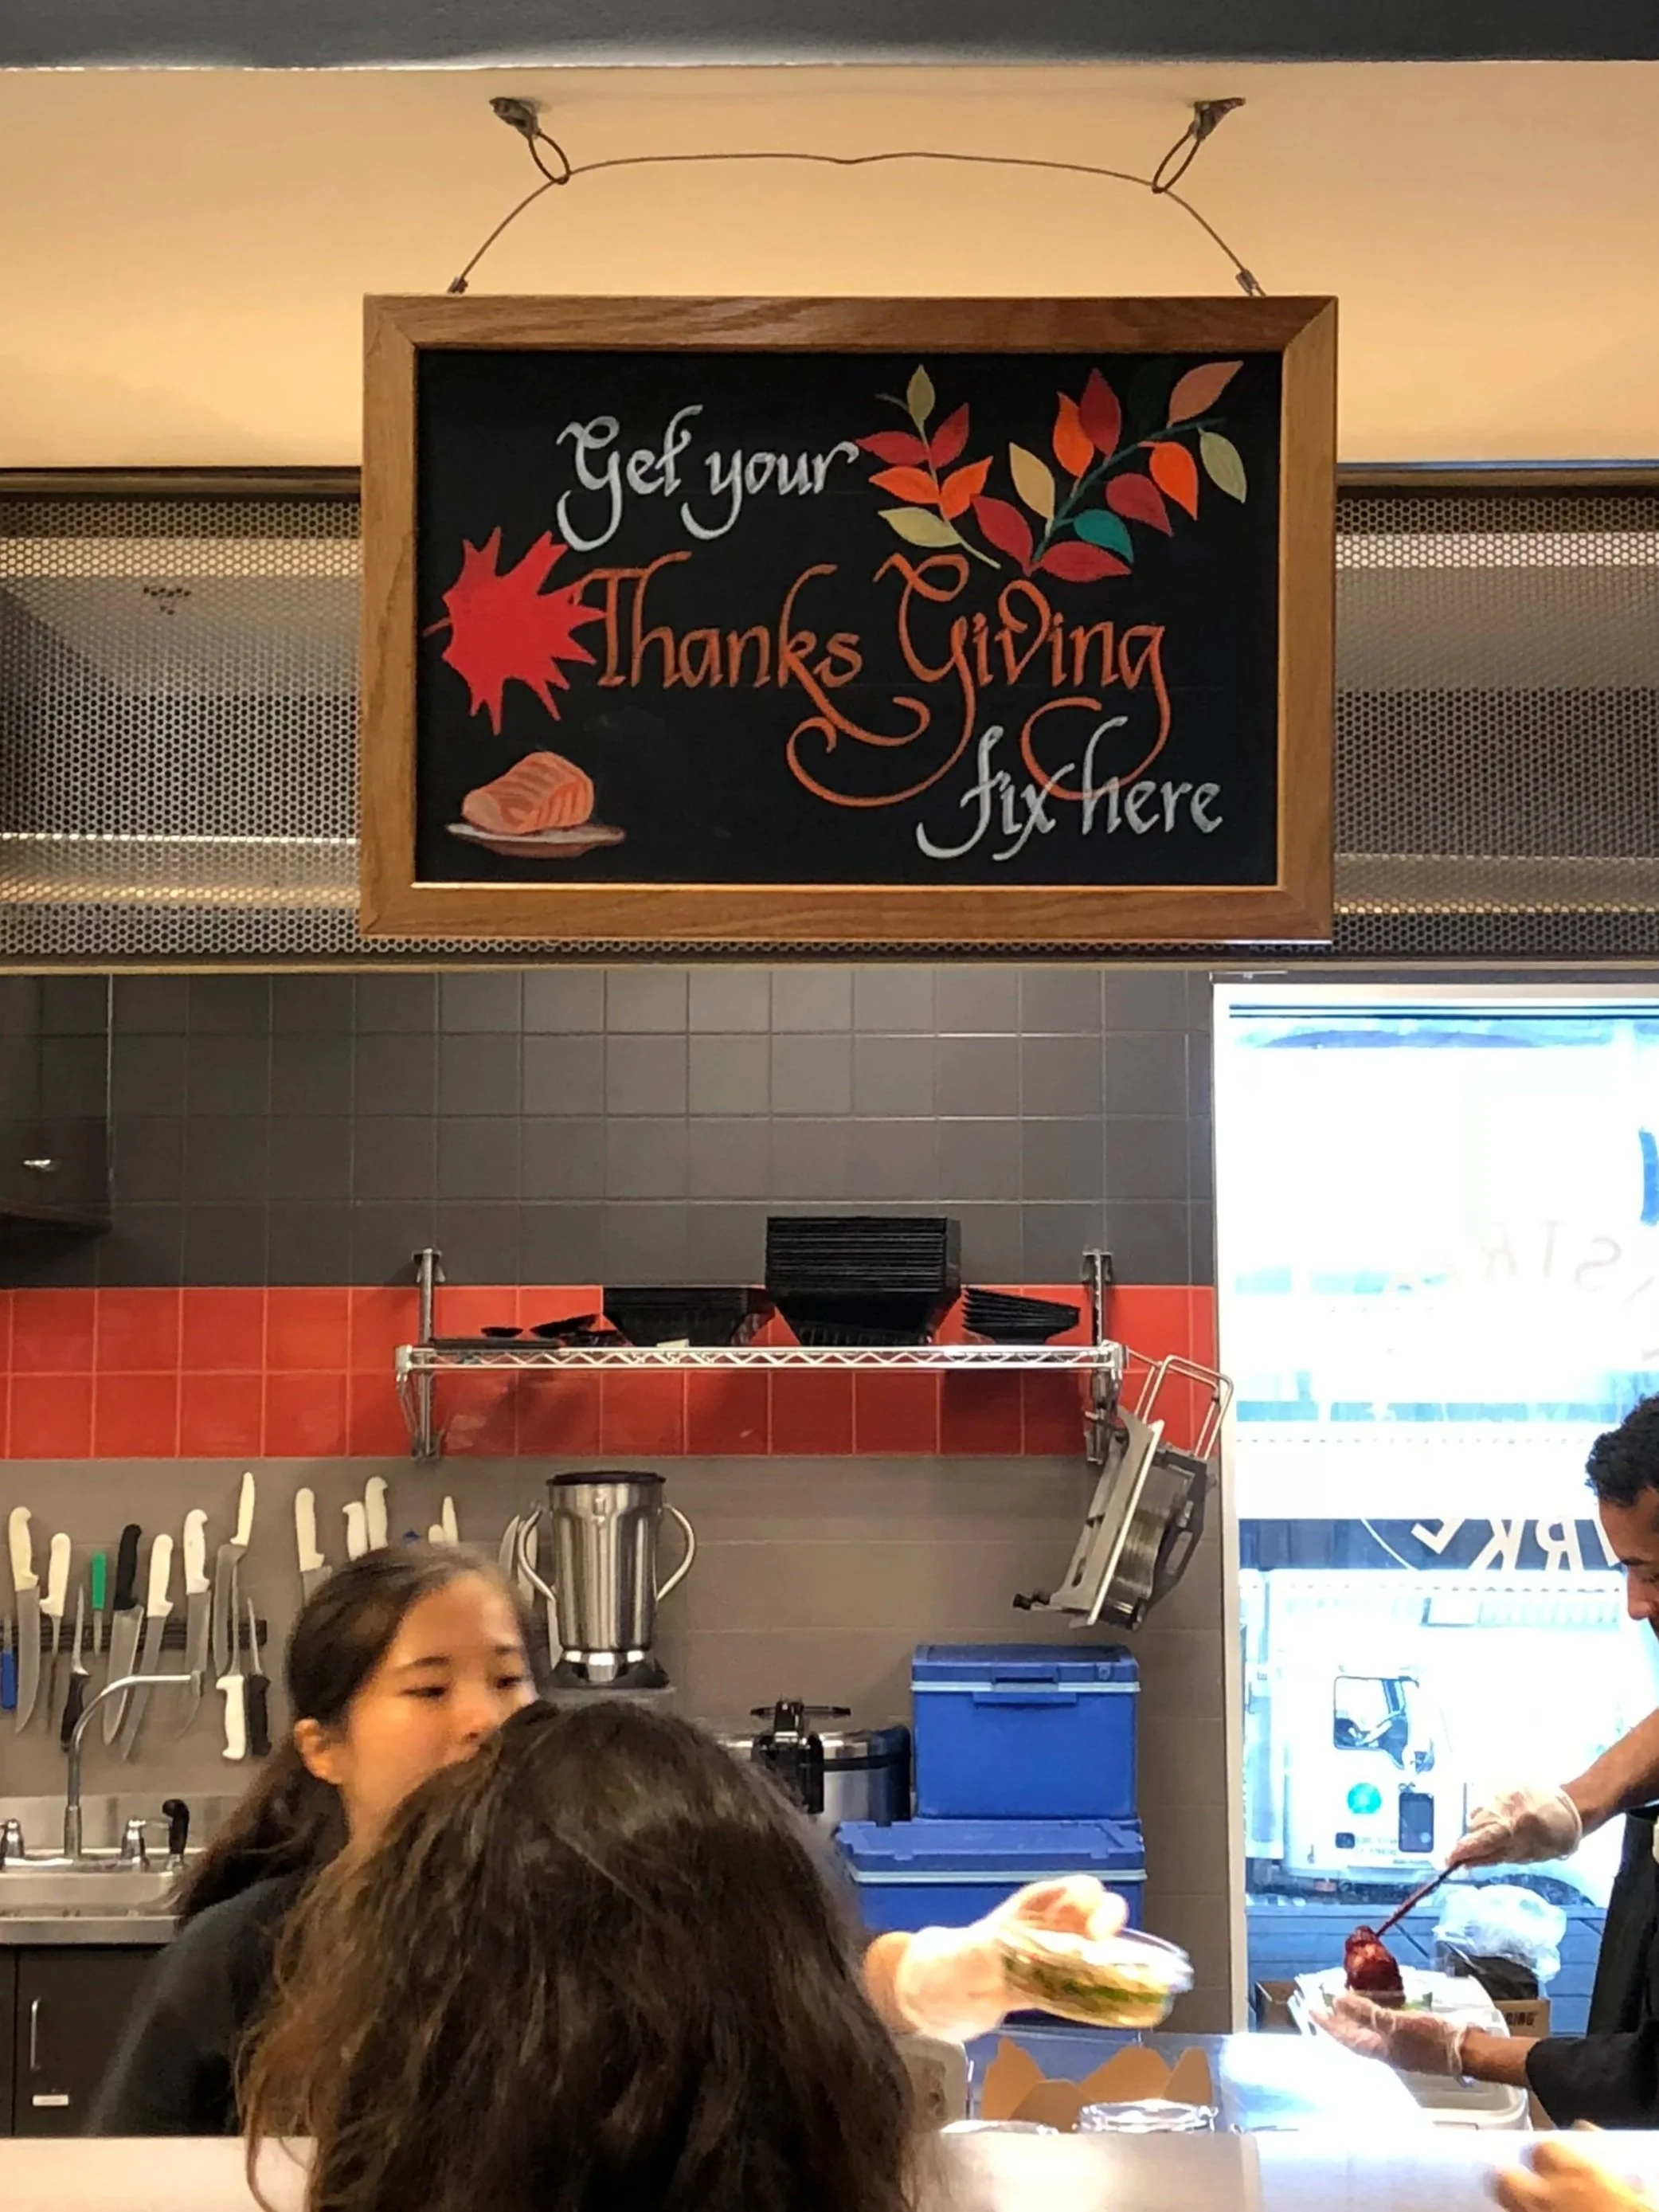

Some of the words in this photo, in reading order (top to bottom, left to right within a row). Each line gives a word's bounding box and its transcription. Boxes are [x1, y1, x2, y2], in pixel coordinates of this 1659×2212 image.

[557, 405, 703, 551] Get
[681, 440, 860, 540] your
[566, 550, 930, 747] Thanks
[916, 726, 1075, 861] fix
[1082, 716, 1223, 834] here
